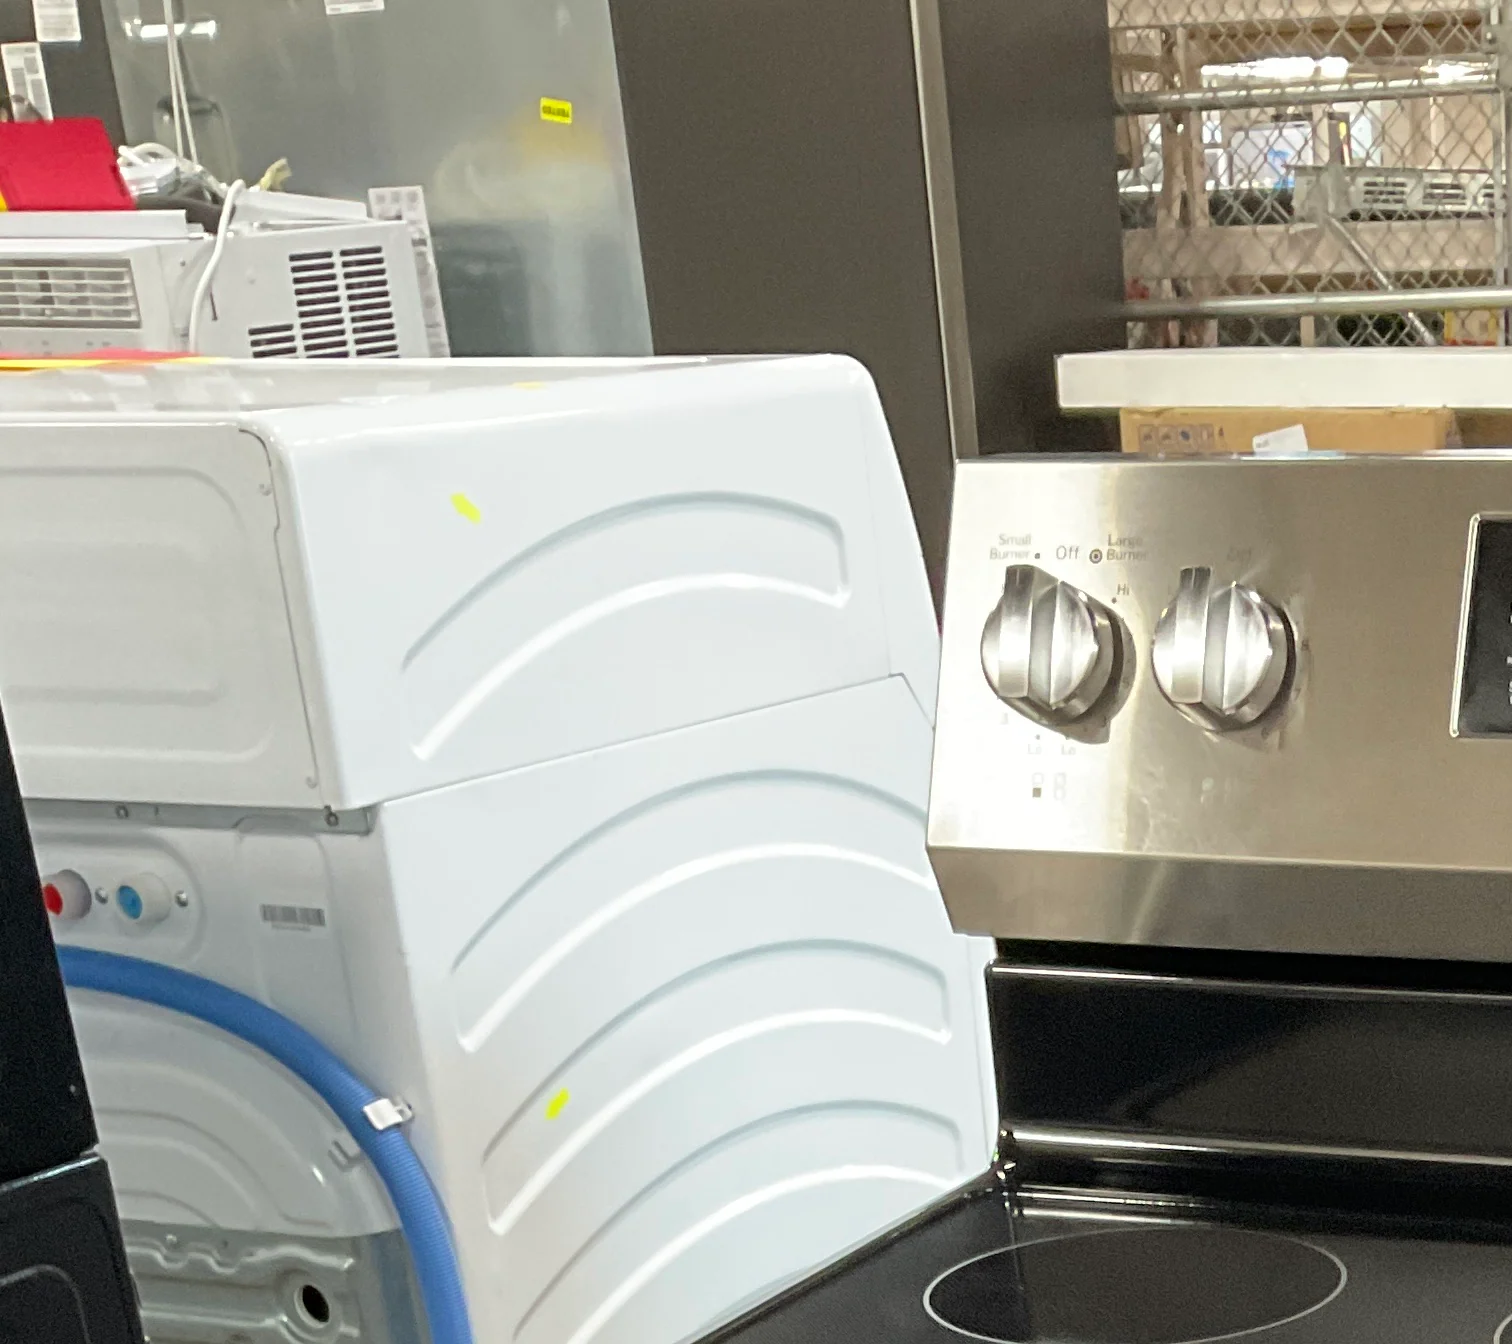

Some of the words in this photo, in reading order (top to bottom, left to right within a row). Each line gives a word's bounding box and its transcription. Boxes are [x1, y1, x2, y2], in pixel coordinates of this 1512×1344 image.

[999, 533, 1031, 546] Small
[1107, 534, 1143, 548] Large
[989, 547, 1030, 560] Burner
[1055, 545, 1080, 560] Off
[1106, 548, 1147, 561] Burner
[1116, 584, 1130, 596] Hi
